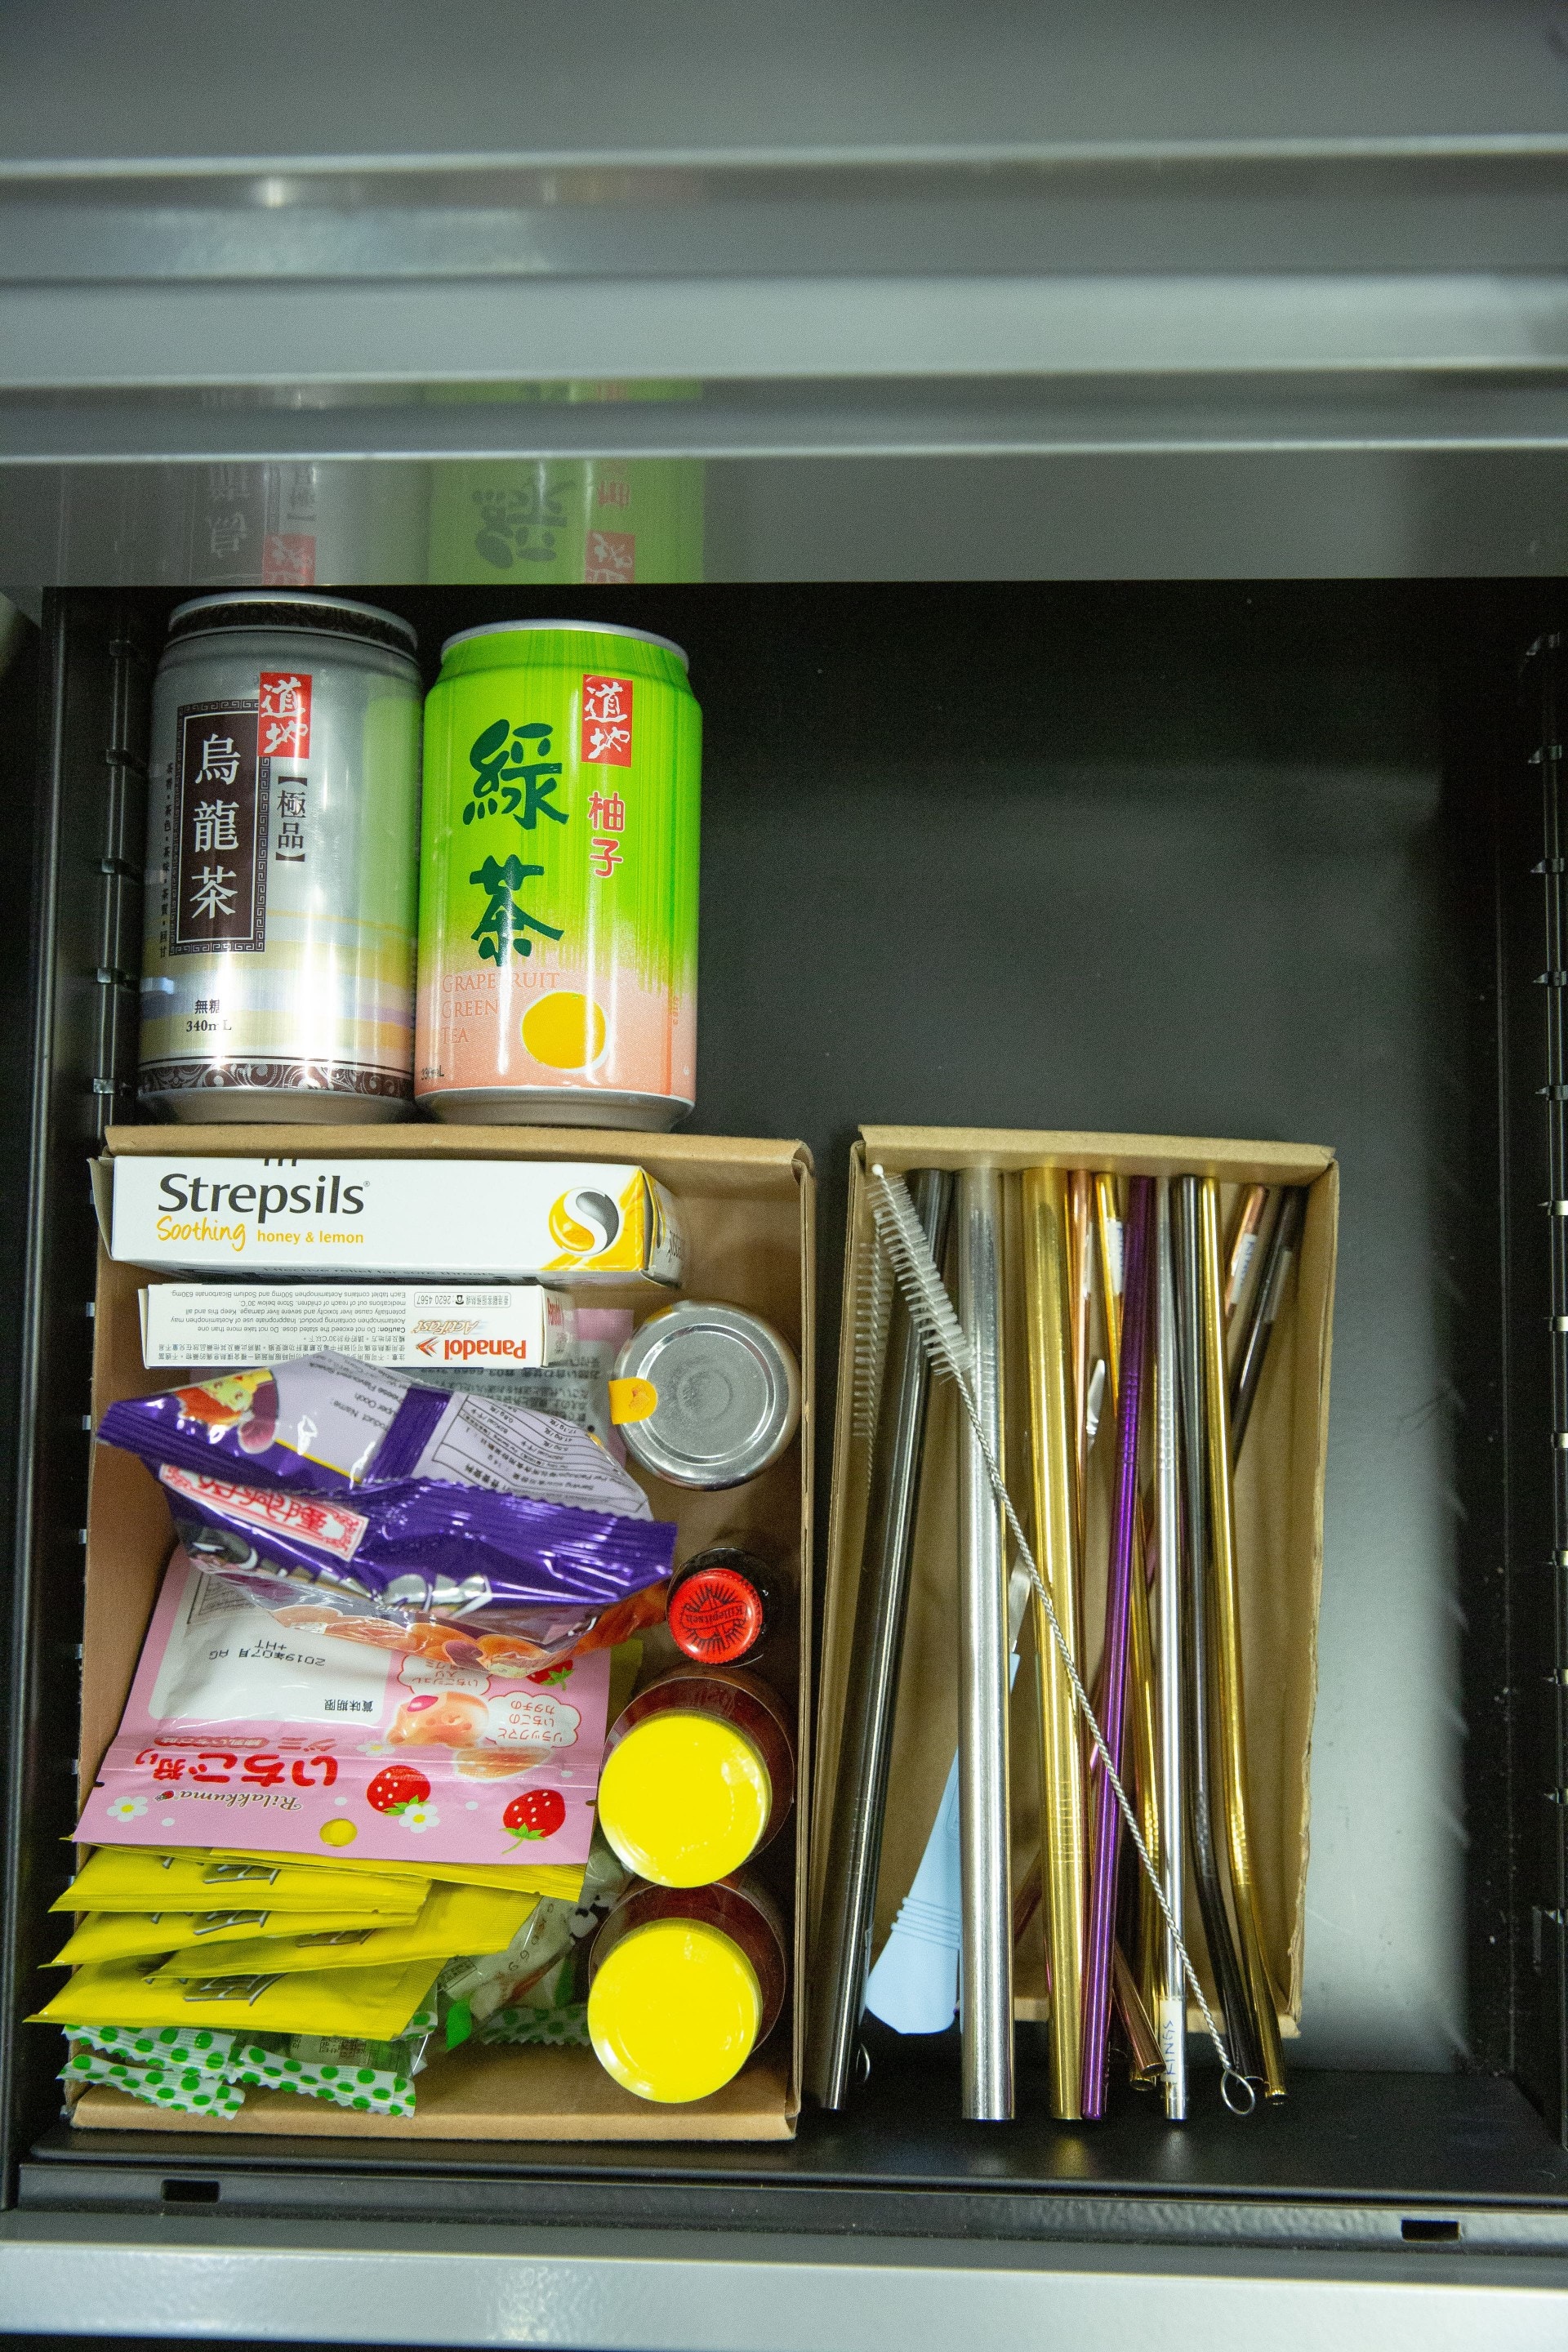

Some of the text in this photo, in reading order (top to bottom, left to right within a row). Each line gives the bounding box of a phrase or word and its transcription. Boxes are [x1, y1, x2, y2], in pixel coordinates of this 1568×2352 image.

[189, 733, 241, 920] 烏龍茶
[588, 791, 625, 880] 柚子
[442, 972, 560, 993] GRAPERUIT
[441, 999, 500, 1019] GREEN
[441, 1026, 470, 1045] TEA
[158, 1173, 365, 1224] Strepsils
[156, 1214, 246, 1252] Soothing
[257, 1229, 364, 1245] honey & lemon
[272, 1290, 293, 1298] 500mg
[416, 1294, 433, 1305] 4567
[413, 1320, 480, 1335] ActiFast
[444, 1339, 527, 1361] Panadol
[324, 1699, 374, 1713] 賞味期限
[510, 1700, 555, 1714] カタチの
[509, 1713, 555, 1726] いちごの
[497, 1728, 564, 1743] リラックマと
[134, 1748, 339, 1787] いちご狩り
[178, 1789, 303, 1811] Rilakkuma
